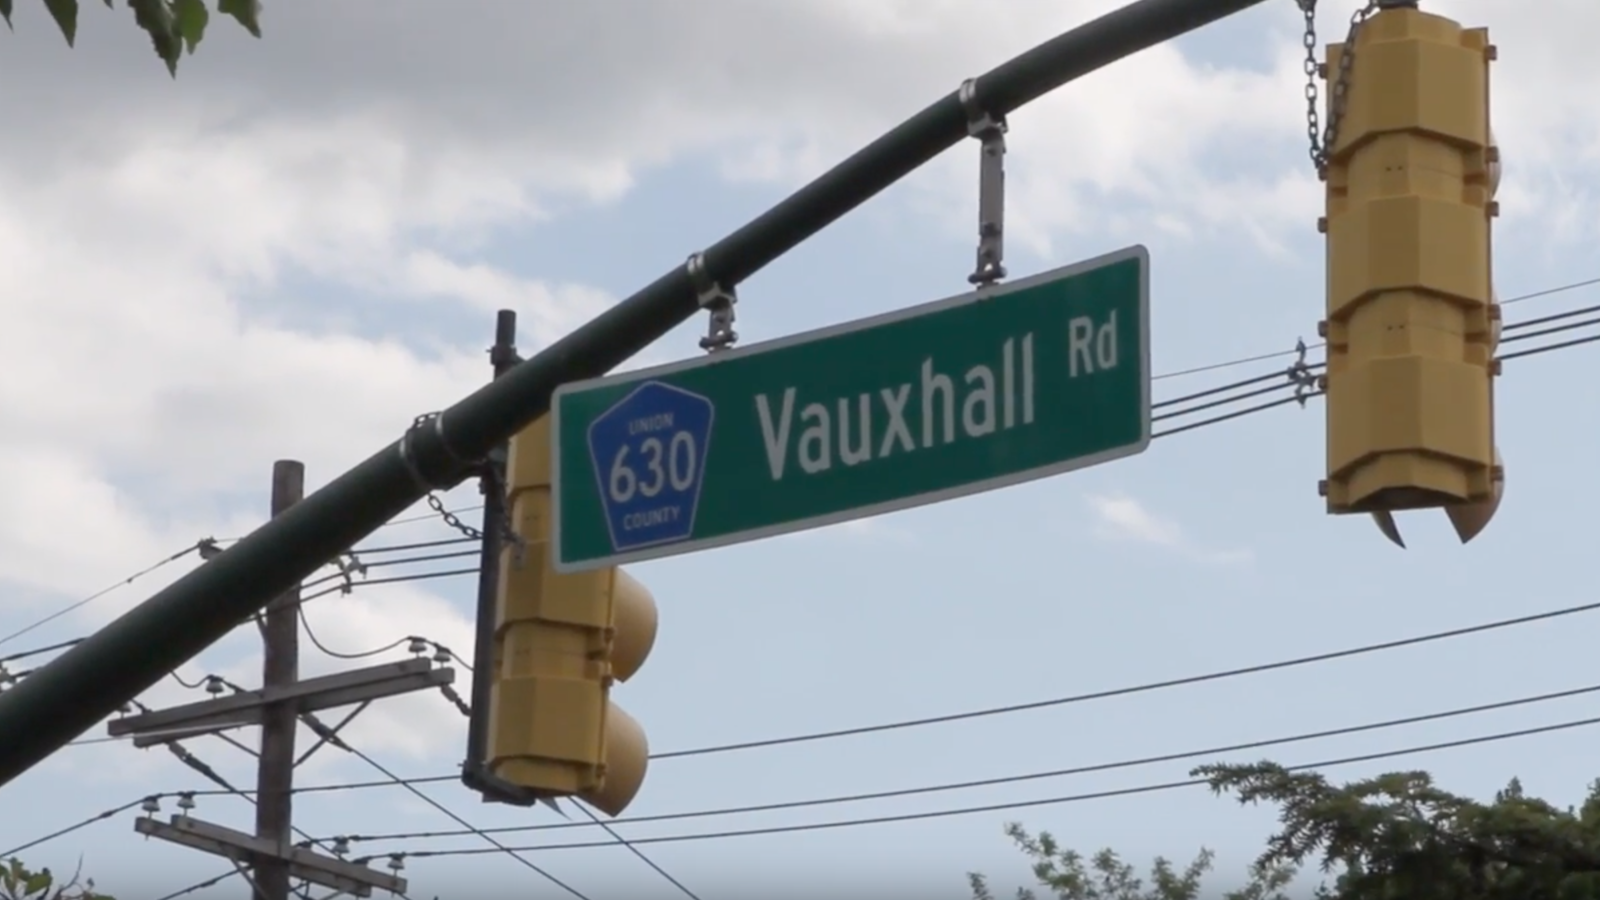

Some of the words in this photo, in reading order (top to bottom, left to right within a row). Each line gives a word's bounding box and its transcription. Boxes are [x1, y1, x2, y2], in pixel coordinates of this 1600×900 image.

[755, 332, 1035, 481] Vauxhall
[1068, 309, 1119, 377] Rd
[629, 412, 674, 435] UNION
[609, 430, 696, 502] 630
[623, 505, 680, 531] COUNTY
